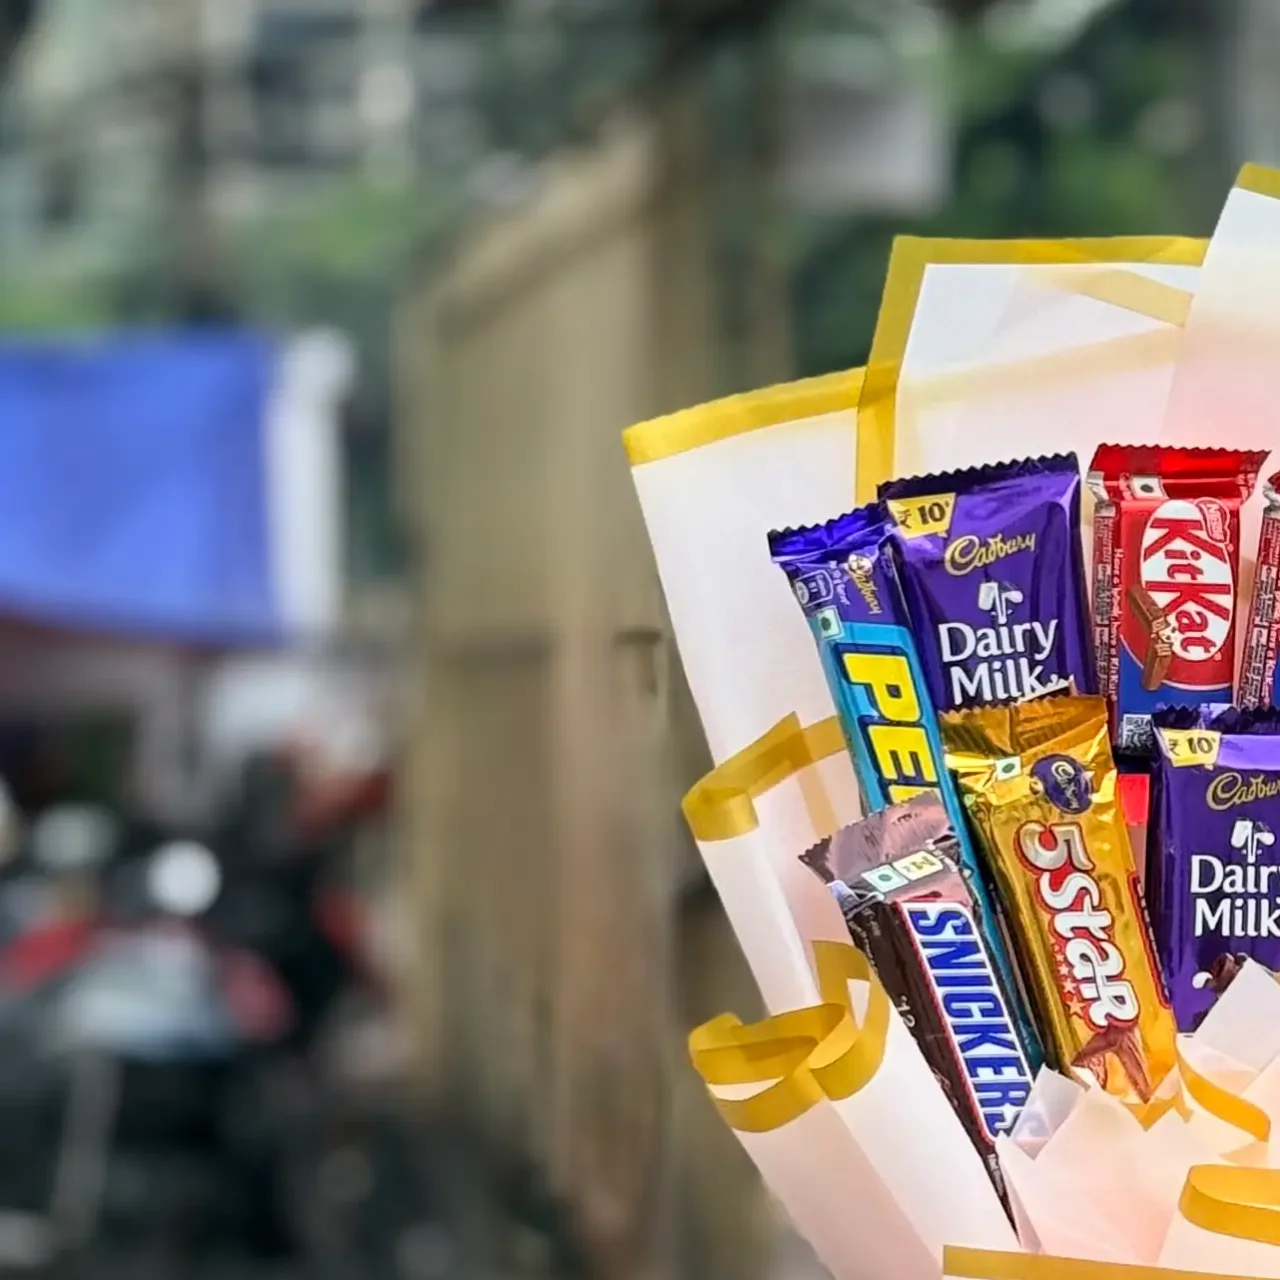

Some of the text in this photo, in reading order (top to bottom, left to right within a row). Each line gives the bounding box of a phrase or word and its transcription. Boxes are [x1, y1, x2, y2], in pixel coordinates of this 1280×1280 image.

[945, 534, 1036, 576] Cadbury
[938, 619, 1058, 663] Dairy
[950, 657, 1047, 706] Milk
[842, 652, 940, 804] PE
